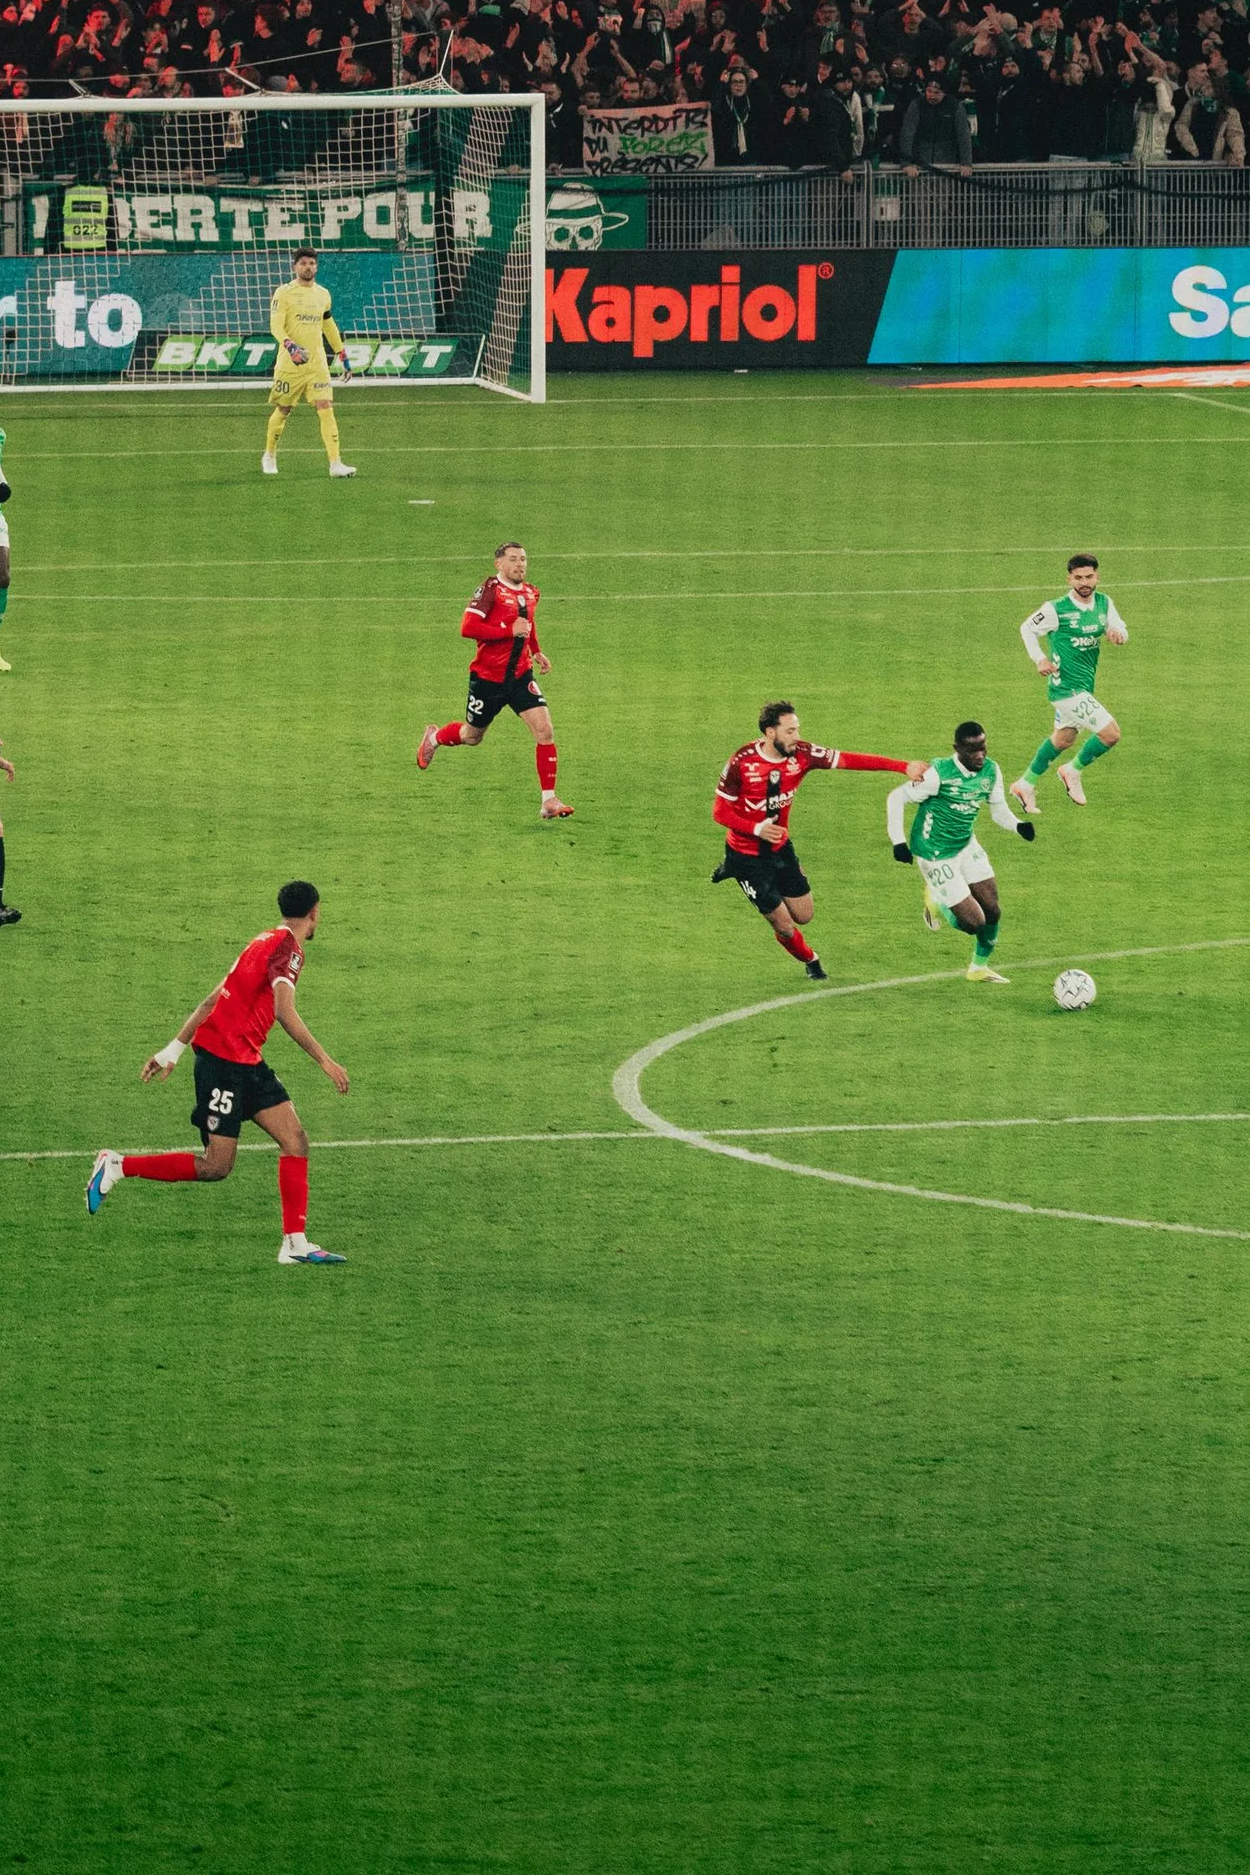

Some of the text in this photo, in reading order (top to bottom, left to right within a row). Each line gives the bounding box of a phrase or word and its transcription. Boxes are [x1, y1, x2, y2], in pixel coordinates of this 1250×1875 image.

[321, 191, 492, 240] POUR
[47, 280, 142, 348] to
[158, 342, 279, 366] BKT
[345, 344, 454, 368] BKT
[276, 380, 290, 394] 30
[468, 694, 485, 715] 22
[934, 863, 955, 885] 20
[740, 879, 757, 900] 14
[208, 1087, 235, 1115] 25
